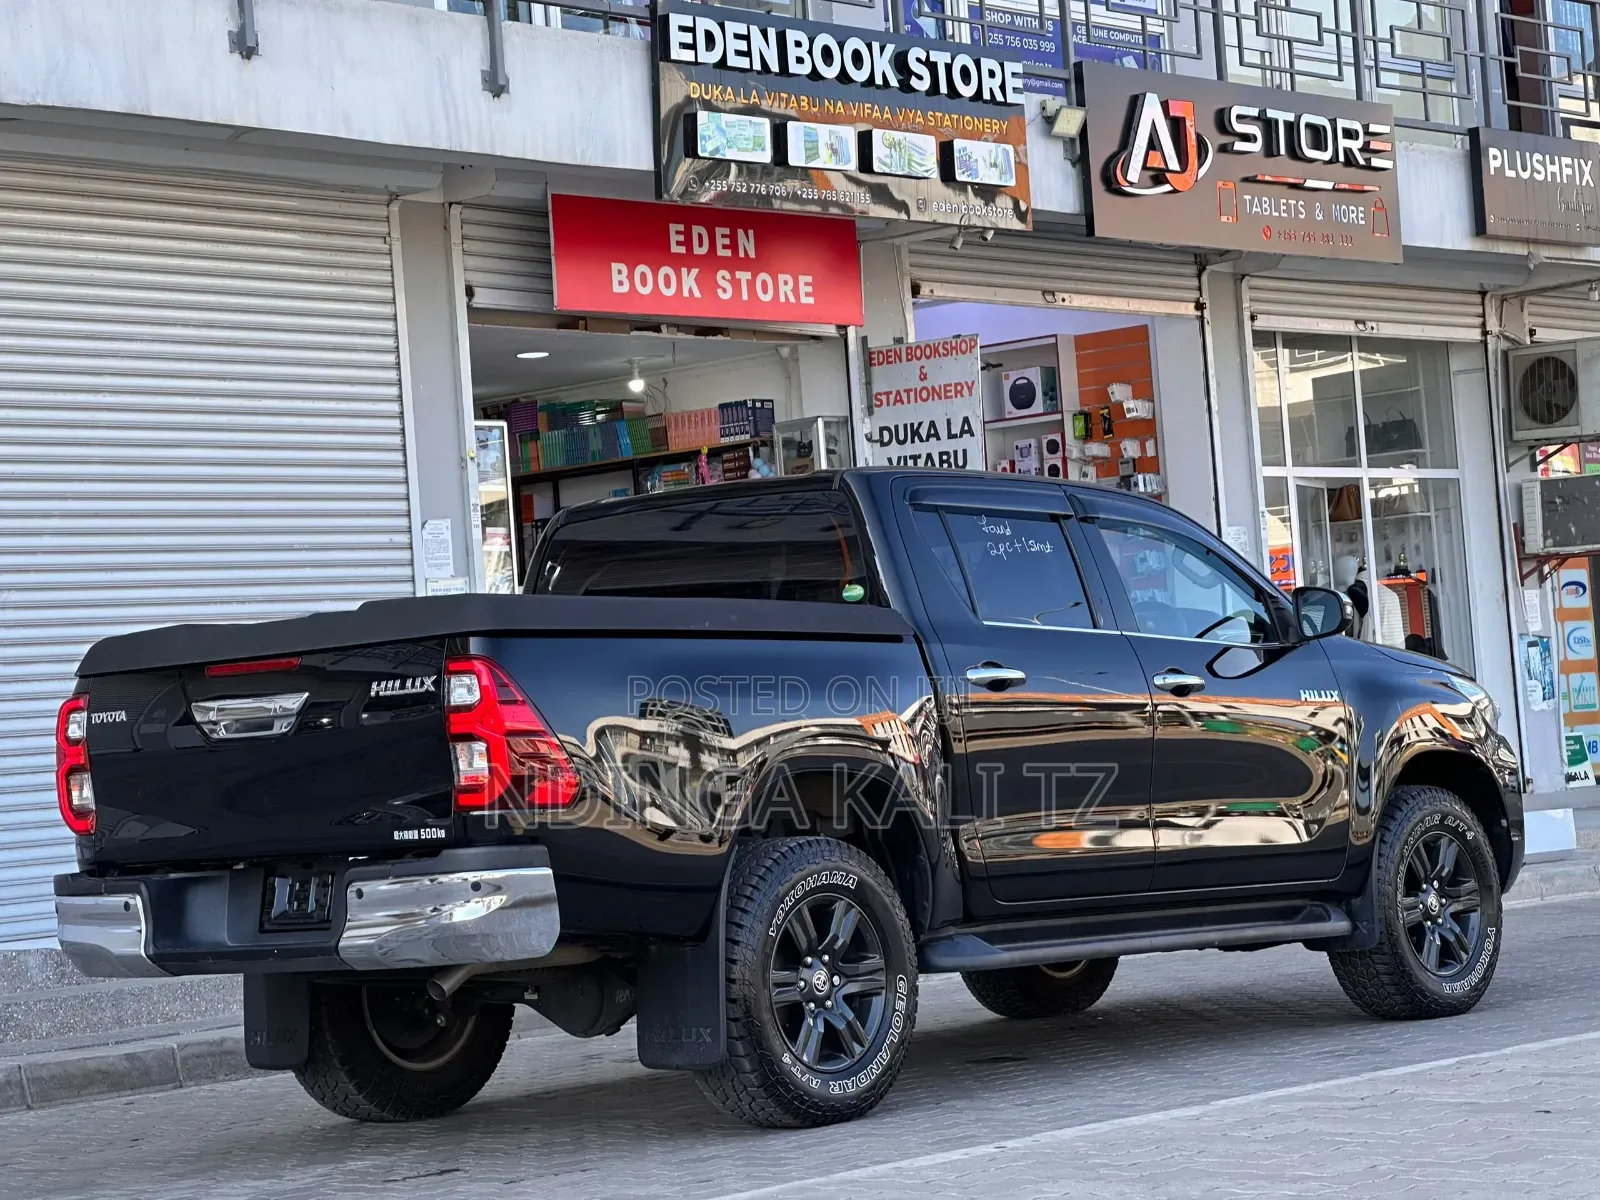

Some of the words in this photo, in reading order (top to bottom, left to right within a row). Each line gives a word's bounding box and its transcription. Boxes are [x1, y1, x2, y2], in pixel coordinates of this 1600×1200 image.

[985, 10, 1011, 24] SHOP
[1013, 14, 1039, 29] WITH
[988, 32, 1004, 45] 255
[1005, 35, 1021, 48] 756
[1022, 38, 1038, 51] 035
[1039, 41, 1056, 53] 999
[1109, 30, 1144, 44] COMPUTE
[668, 12, 780, 74] EDEN
[785, 28, 901, 90] BOOK
[906, 46, 1025, 105] STORE
[689, 81, 736, 102] DUKA
[740, 87, 761, 106] LA
[764, 90, 820, 112] VITABU
[824, 98, 846, 115] NA
[849, 101, 894, 123] VIFAA
[895, 107, 925, 125] VYA
[927, 109, 1009, 136] STATIONERY
[1229, 104, 1394, 169] STORE
[1488, 146, 1595, 188] PLUSHFIX
[704, 180, 728, 192] +255
[730, 181, 747, 193] 752
[749, 182, 767, 195] 776
[768, 184, 787, 197] 706
[796, 186, 819, 200] +255
[820, 188, 838, 202] 785
[839, 189, 855, 202] 621
[856, 190, 872, 204] 155
[932, 200, 1015, 219] eden.bookstore
[1243, 194, 1307, 220] TABLETS
[1315, 202, 1325, 221] &
[1332, 203, 1366, 225] MORE
[668, 222, 756, 259] EDEN
[610, 261, 702, 299] BOOK
[715, 268, 815, 305] STORE
[868, 347, 903, 368] EDEN
[905, 337, 978, 363] BOOKSHOP
[918, 365, 928, 382] &
[873, 380, 976, 409] STATIONERY
[878, 420, 941, 448] DUKA
[946, 415, 975, 440] LA
[370, 674, 437, 697] HILUX
[1299, 689, 1340, 702] HILUX
[91, 710, 127, 724] TOYOTA
[768, 870, 858, 937] YOKOHAMA
[1442, 926, 1496, 994] YOKOHAMA
[829, 973, 908, 1095] GEOLANDAR
